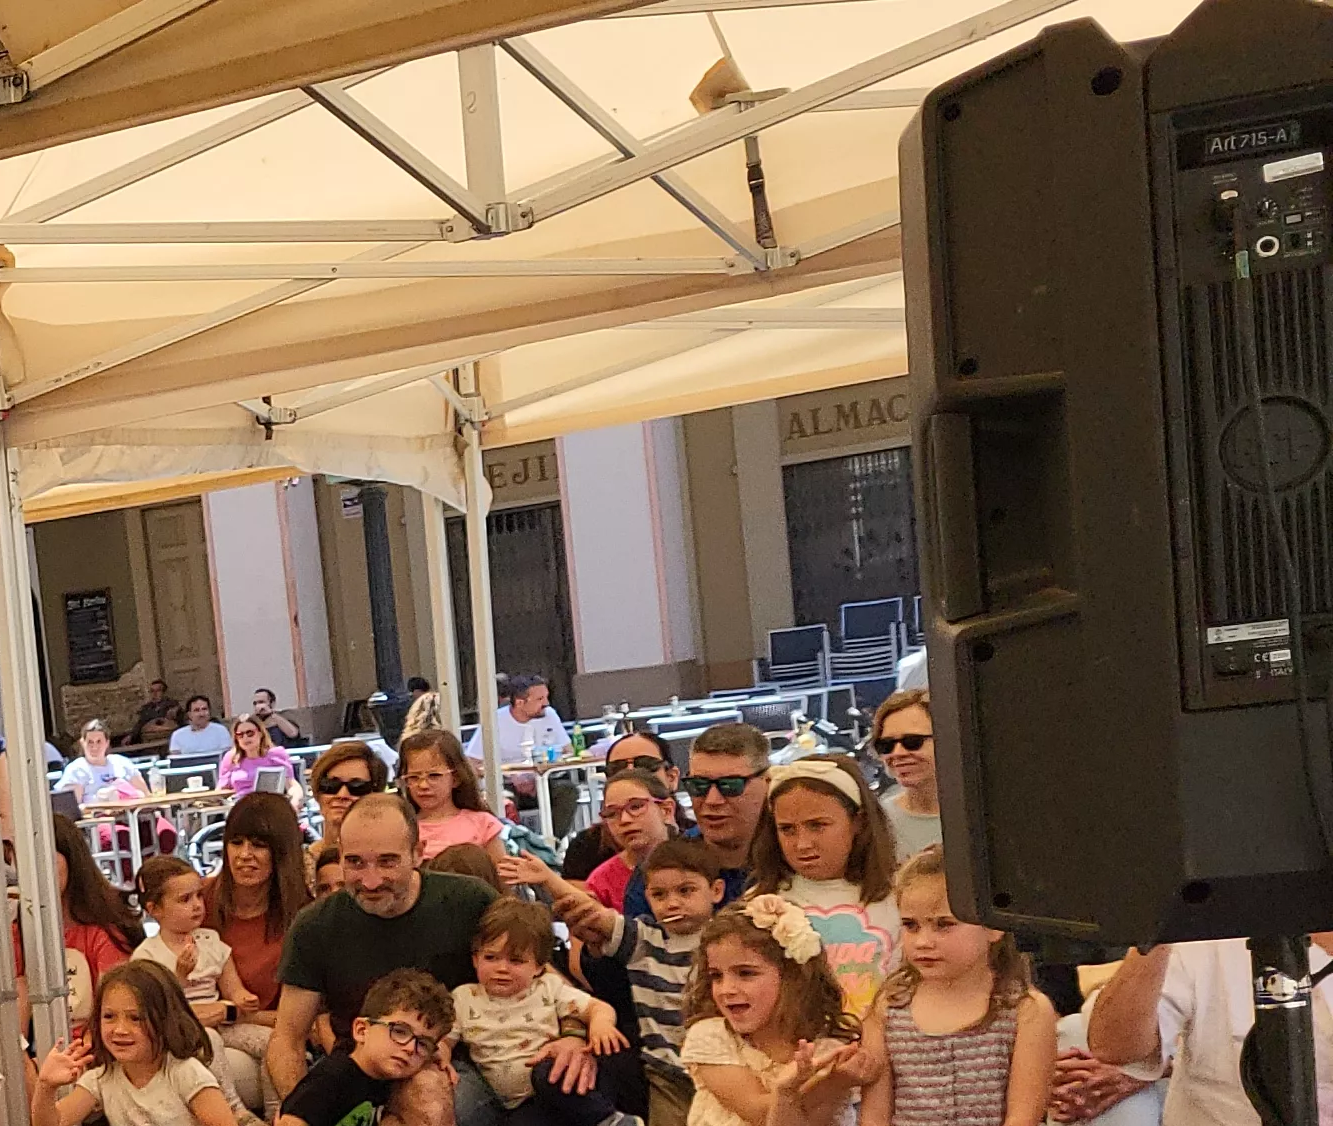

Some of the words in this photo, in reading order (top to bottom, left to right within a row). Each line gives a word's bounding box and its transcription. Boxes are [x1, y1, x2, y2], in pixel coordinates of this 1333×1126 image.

[1209, 135, 1237, 154] Art
[1239, 128, 1288, 149] 715-A
[485, 452, 558, 489] EJI
